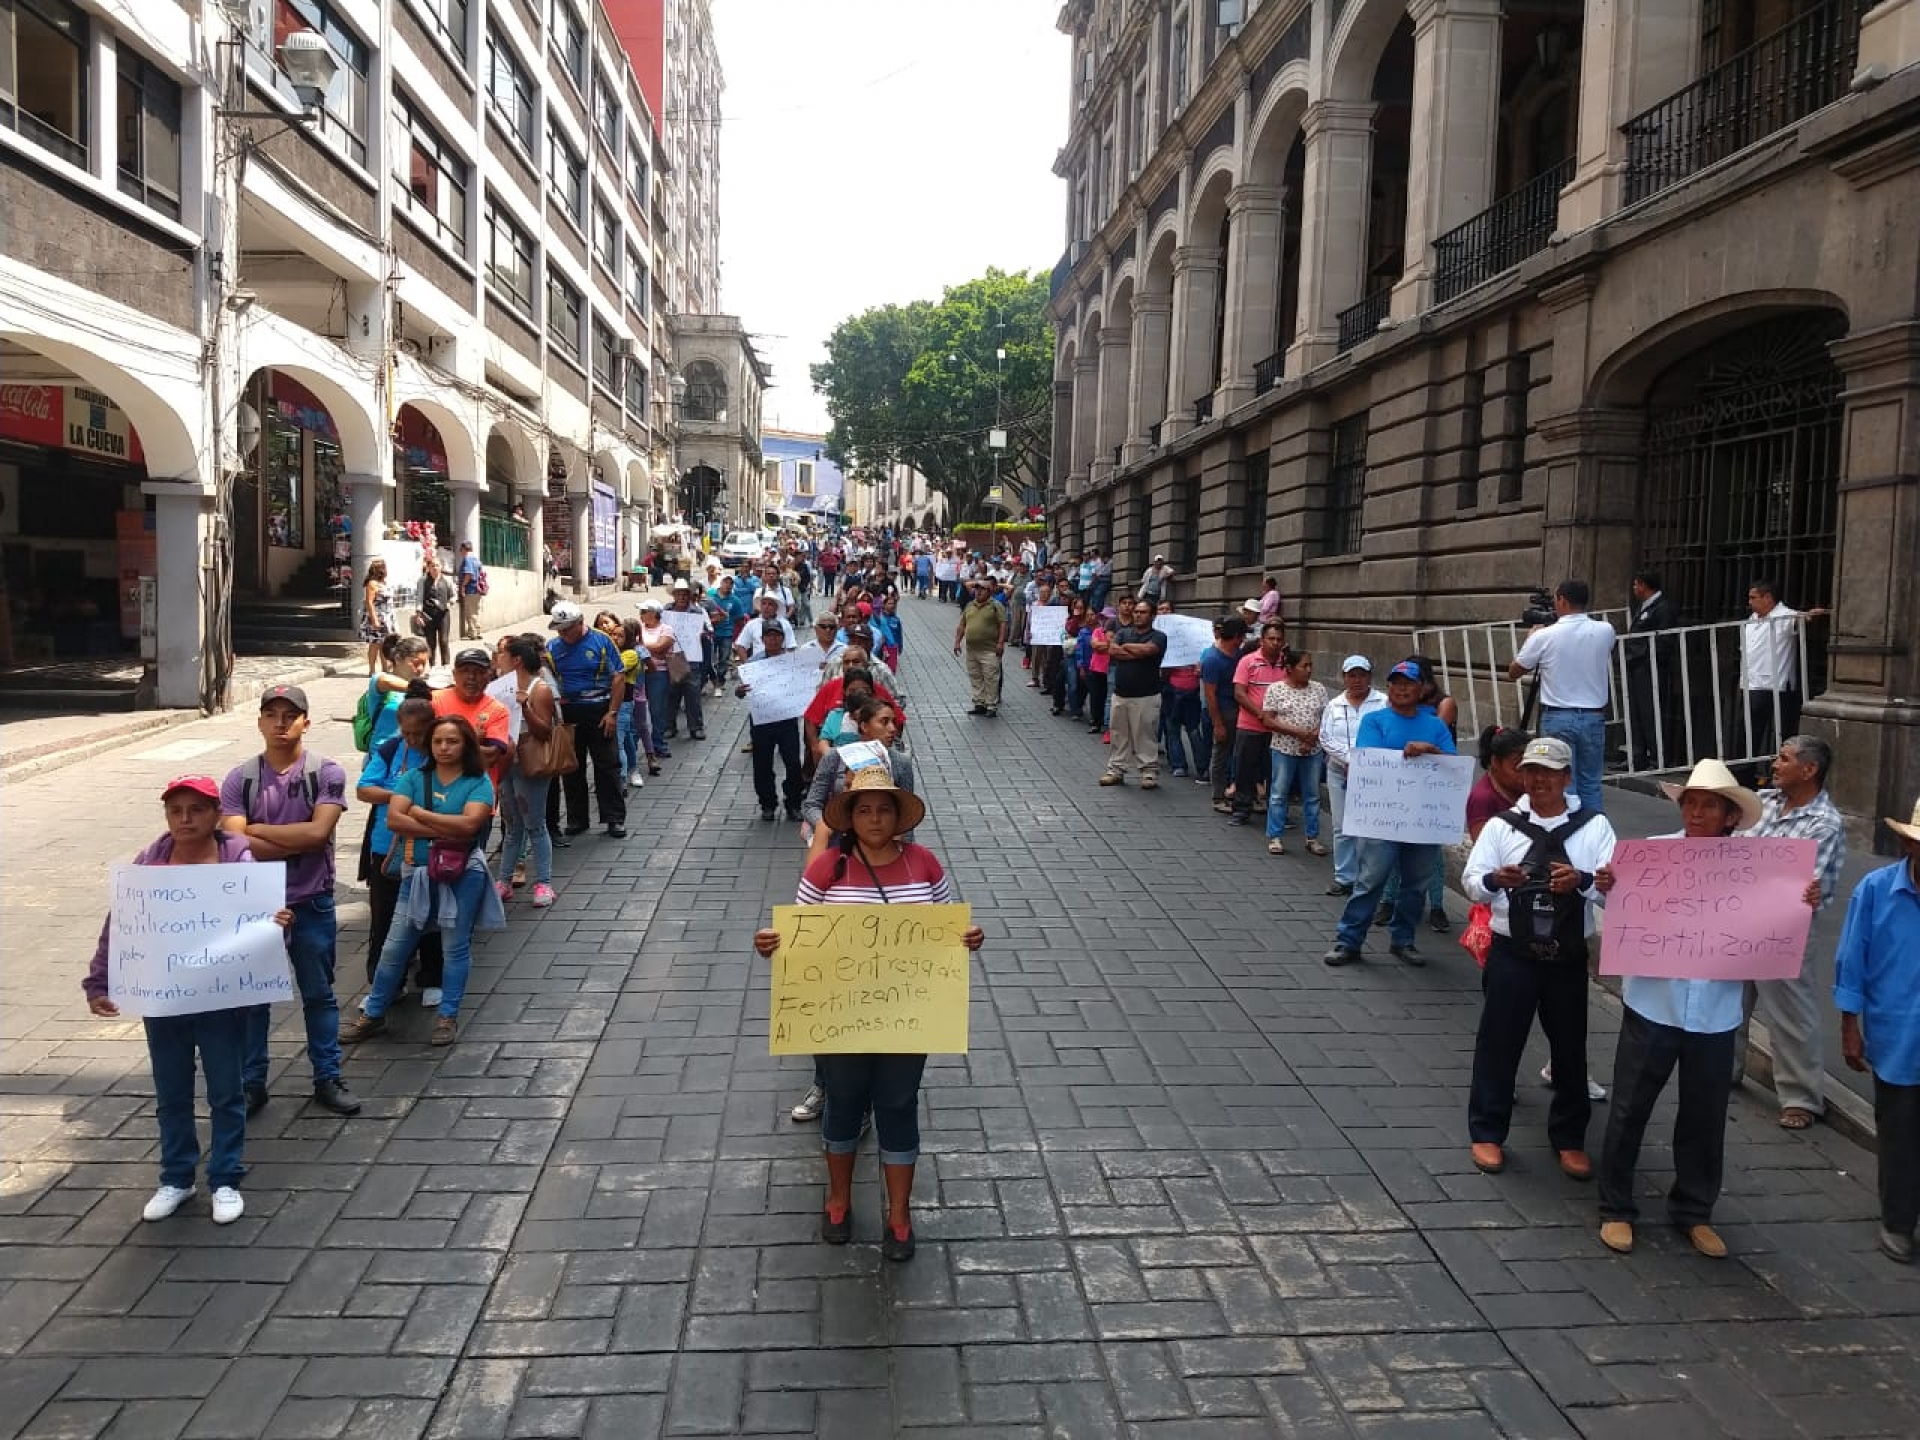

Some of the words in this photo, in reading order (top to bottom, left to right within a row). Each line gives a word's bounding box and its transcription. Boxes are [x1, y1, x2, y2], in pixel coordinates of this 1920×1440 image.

[69, 422, 85, 447] LA
[87, 428, 125, 457] CUEVA
[1396, 777, 1417, 793] que
[221, 875, 248, 895] el
[780, 953, 823, 986] La
[208, 976, 229, 994] de
